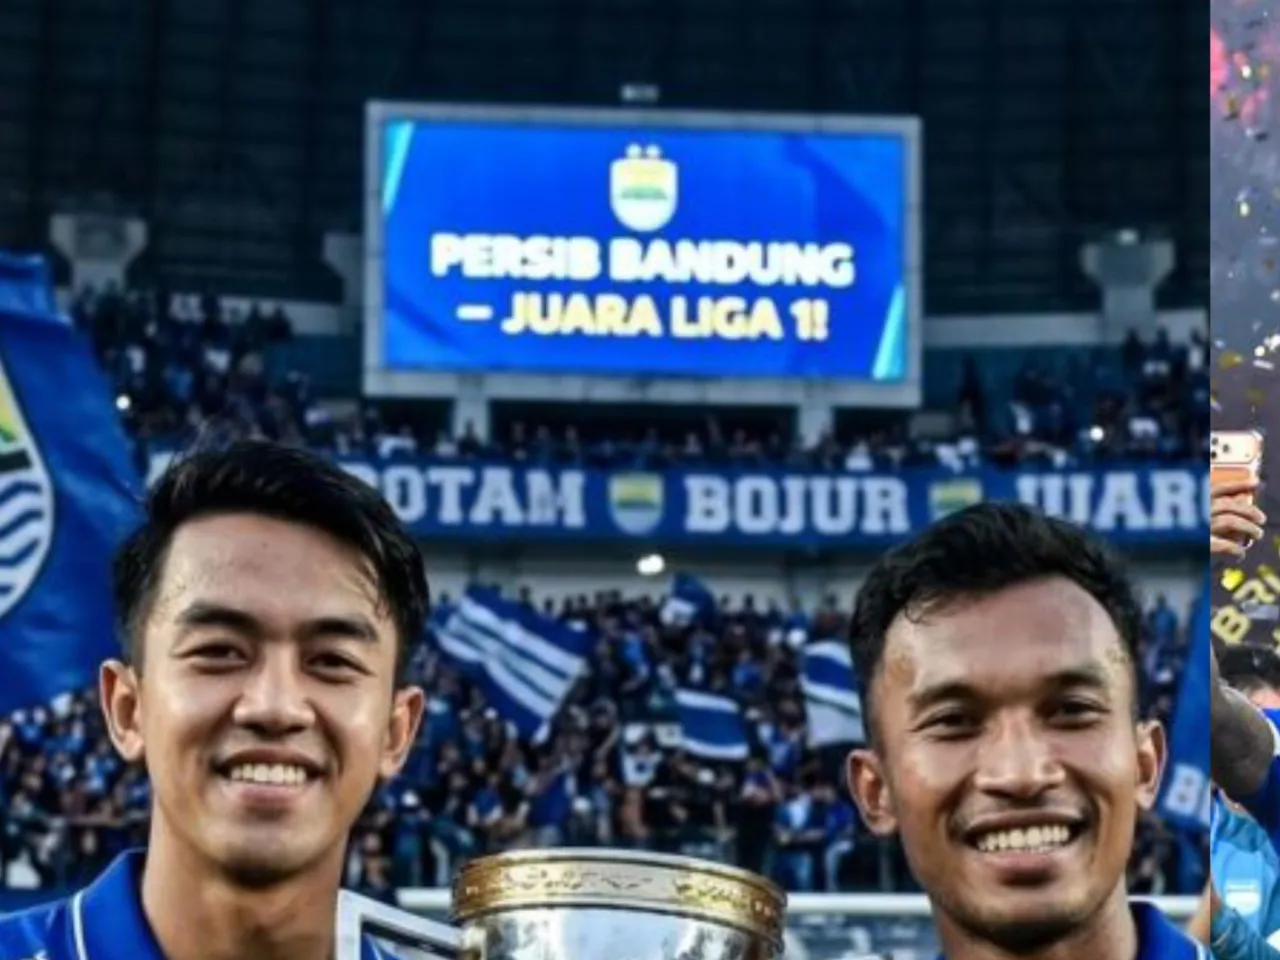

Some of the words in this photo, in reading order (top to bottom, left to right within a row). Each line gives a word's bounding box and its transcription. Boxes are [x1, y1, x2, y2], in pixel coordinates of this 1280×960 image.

[430, 233, 601, 280] PERSIB
[608, 239, 856, 287] BANDUNG
[500, 292, 663, 335] JUARA
[670, 296, 784, 340] LIGA
[790, 300, 829, 341] 1!
[337, 462, 586, 527] OTAM
[684, 475, 911, 535] BOJUR
